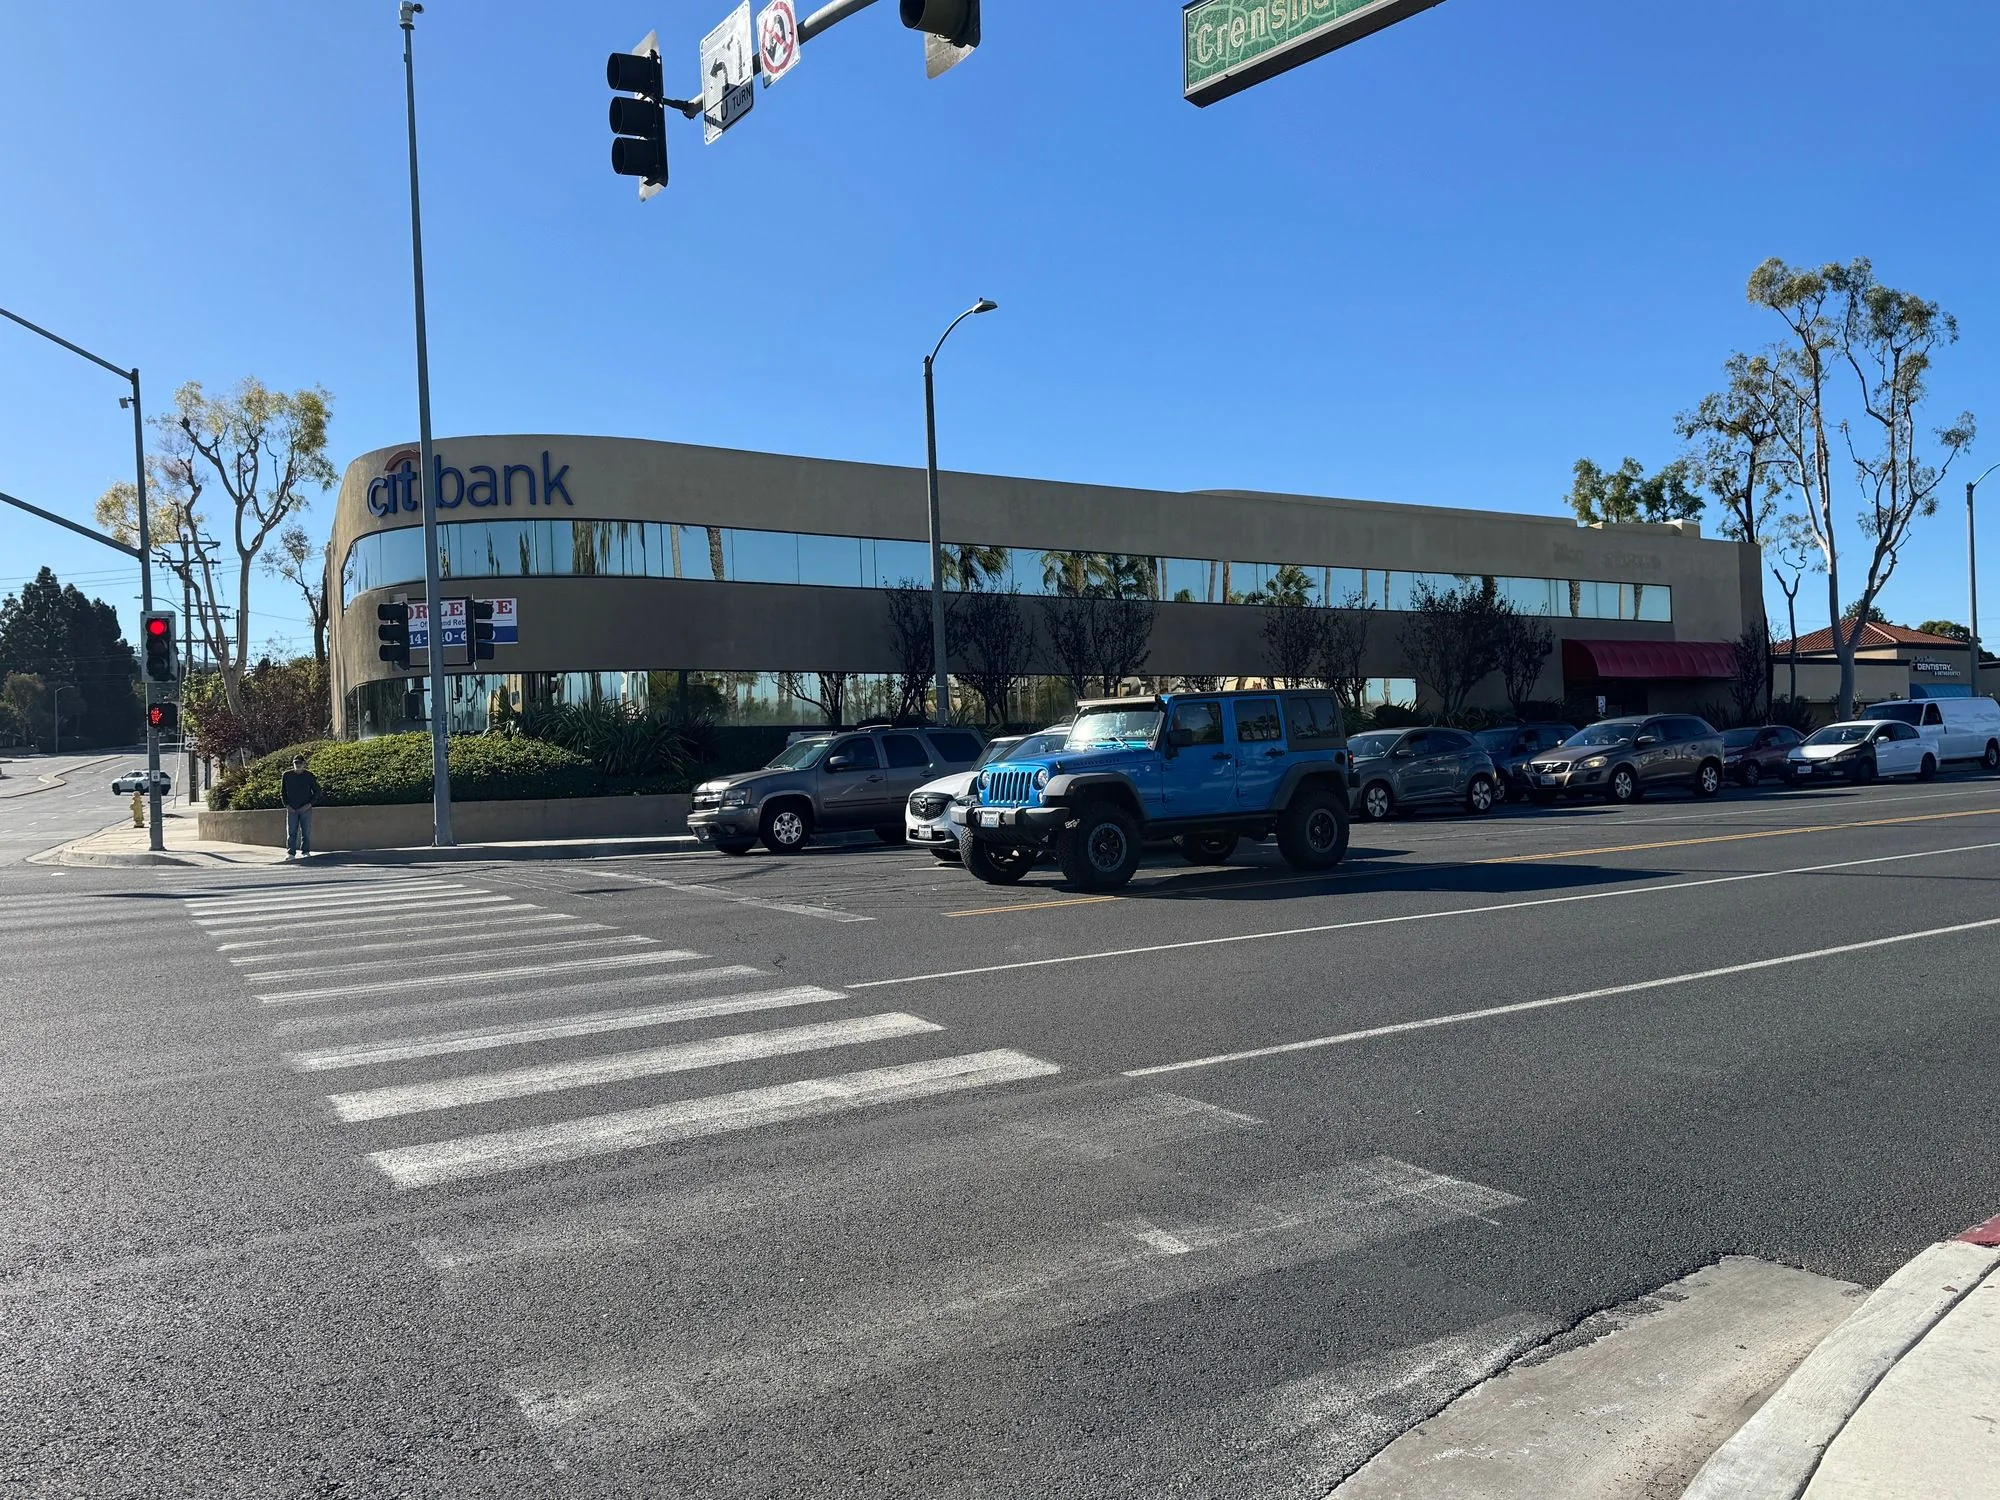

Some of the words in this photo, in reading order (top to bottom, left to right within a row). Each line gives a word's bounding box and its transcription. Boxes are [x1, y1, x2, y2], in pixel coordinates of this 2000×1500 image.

[721, 100, 728, 121] U
[732, 84, 751, 110] TURN
[367, 450, 574, 518] citbank
[407, 604, 428, 620] OR
